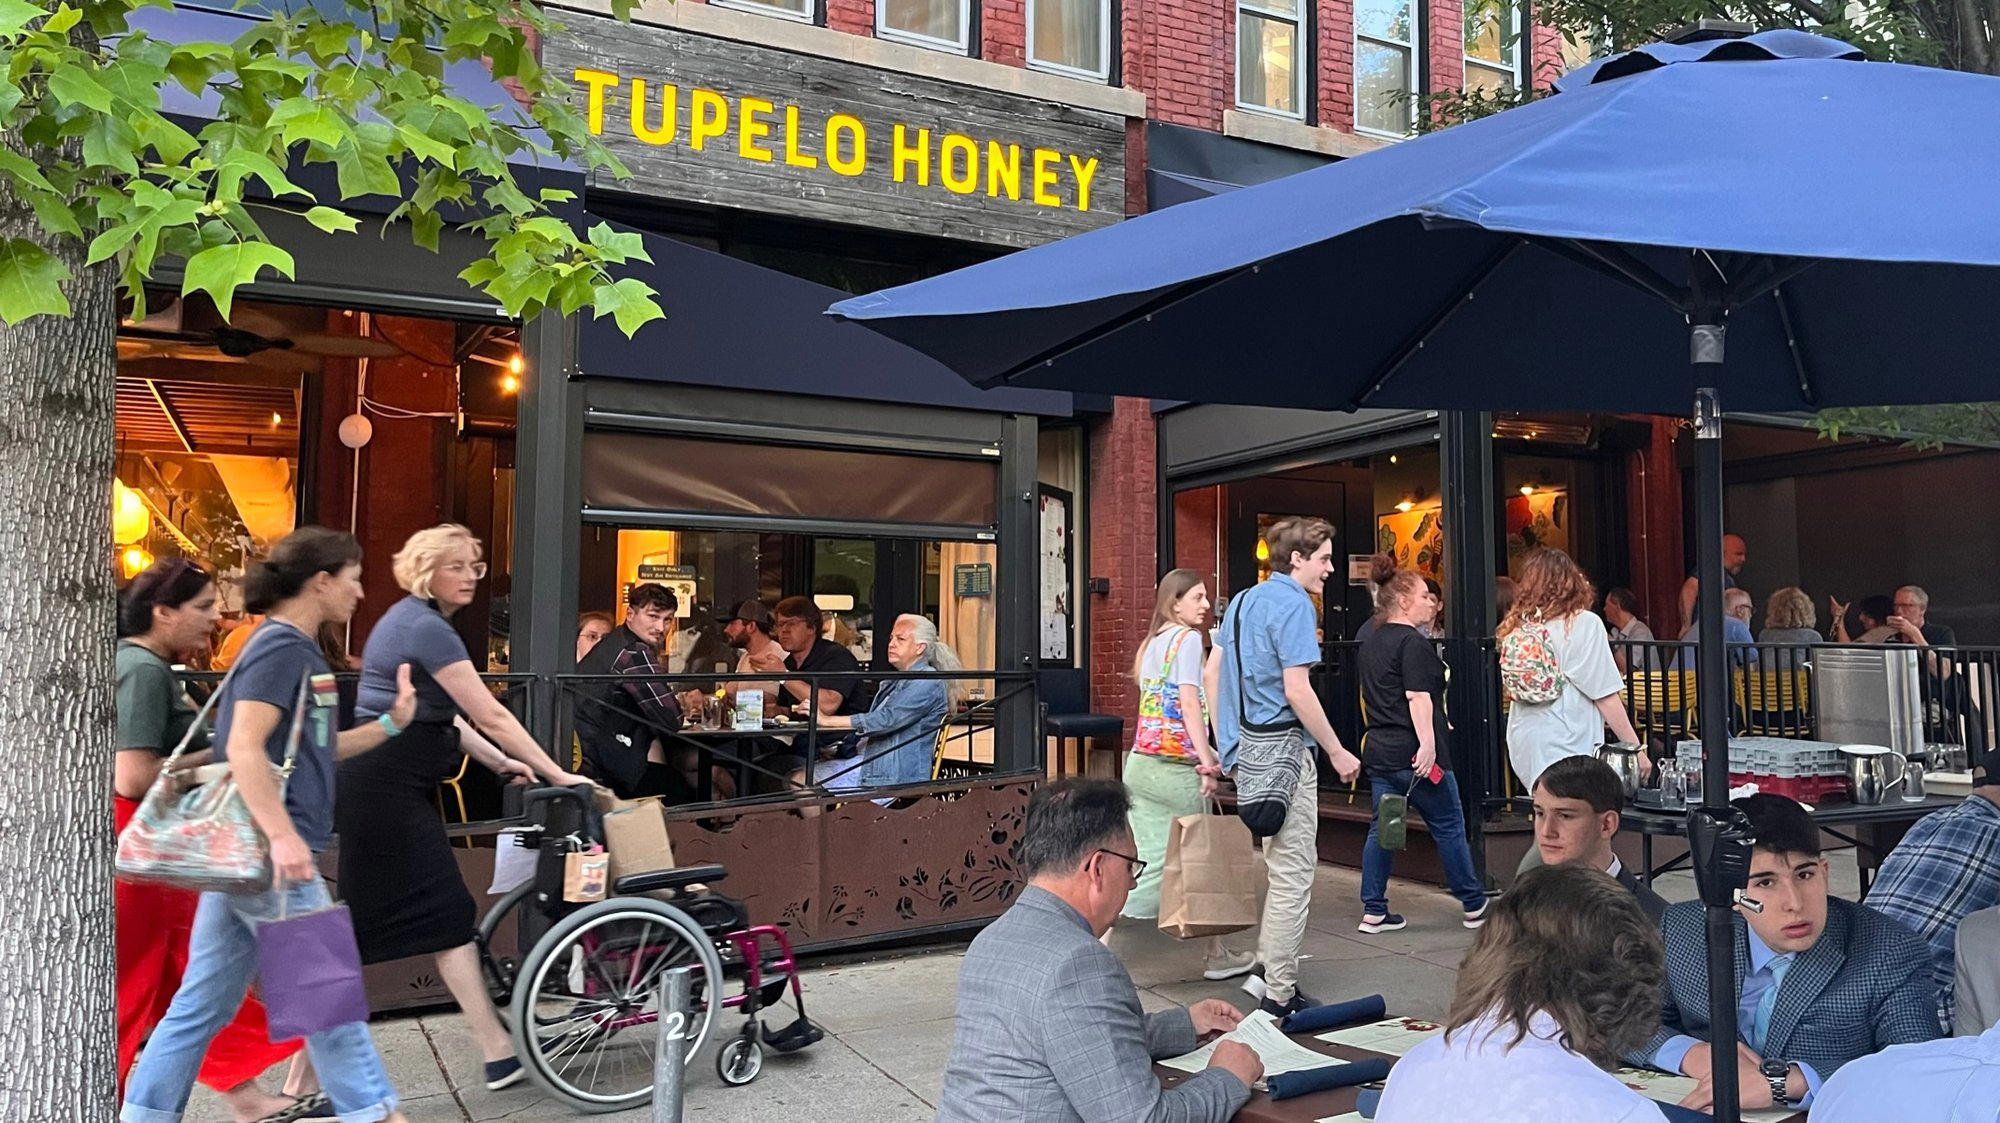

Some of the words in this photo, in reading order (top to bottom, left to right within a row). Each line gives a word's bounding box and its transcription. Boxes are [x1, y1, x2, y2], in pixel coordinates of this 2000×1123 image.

[575, 69, 867, 176] TUPELO
[893, 124, 1099, 212] HONEY
[666, 1011, 685, 1040] 2
